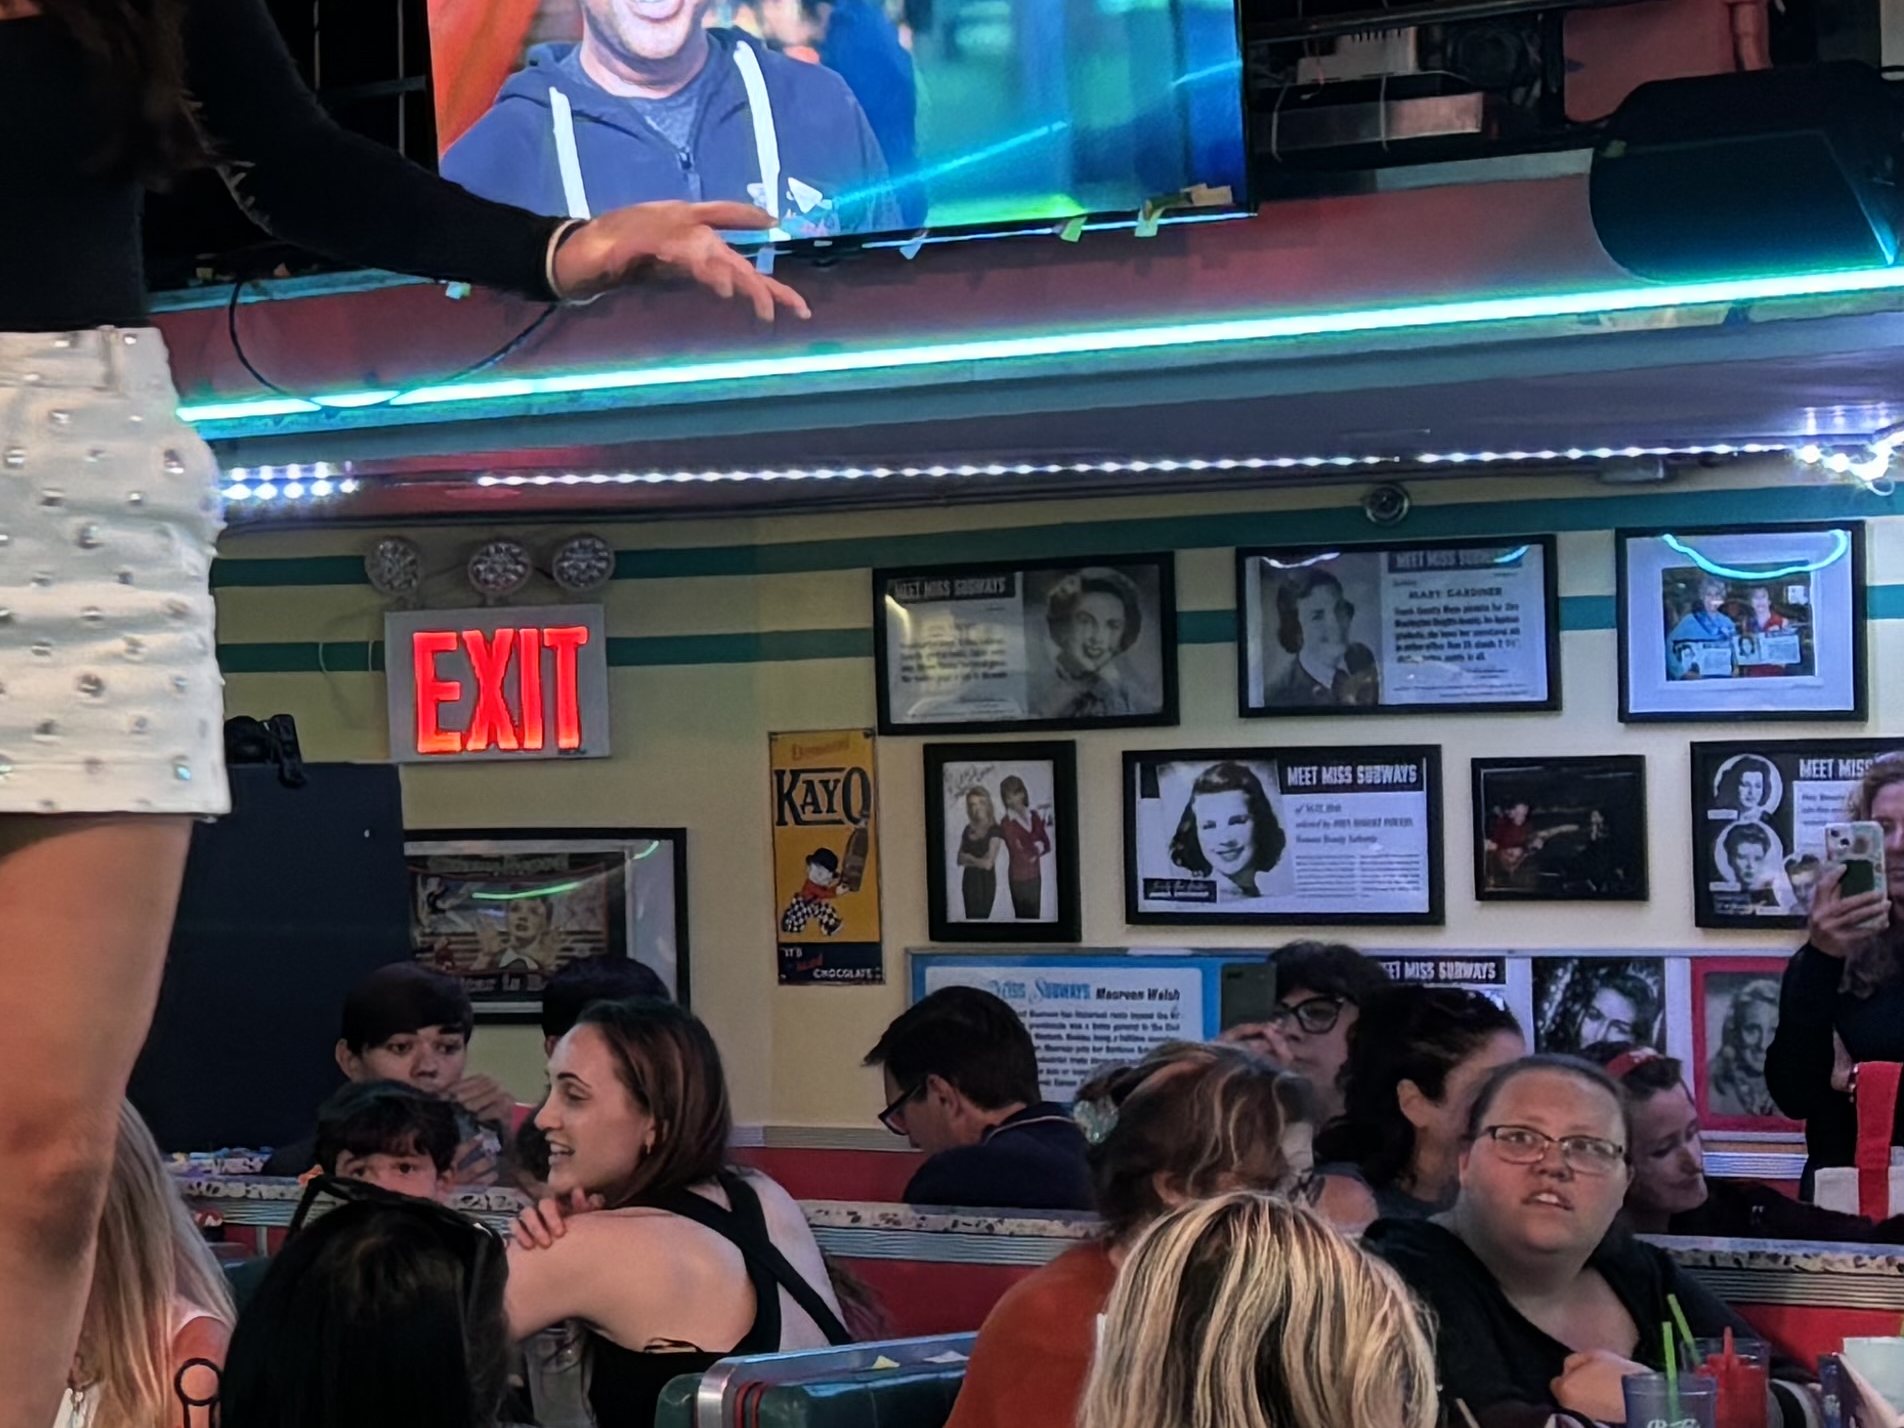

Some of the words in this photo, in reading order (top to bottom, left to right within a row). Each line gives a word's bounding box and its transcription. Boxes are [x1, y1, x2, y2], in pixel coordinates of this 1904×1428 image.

[413, 626, 589, 753] EXIT
[1287, 765, 1318, 786] MEET
[1321, 765, 1353, 785] MISS
[1356, 764, 1418, 785] SUBWAYS
[1799, 758, 1835, 778] MEET
[773, 766, 872, 827] KAYO
[812, 968, 872, 979] CHOCOLATE
[1404, 961, 1435, 980] MISS
[1438, 961, 1496, 980] SUBWAYS
